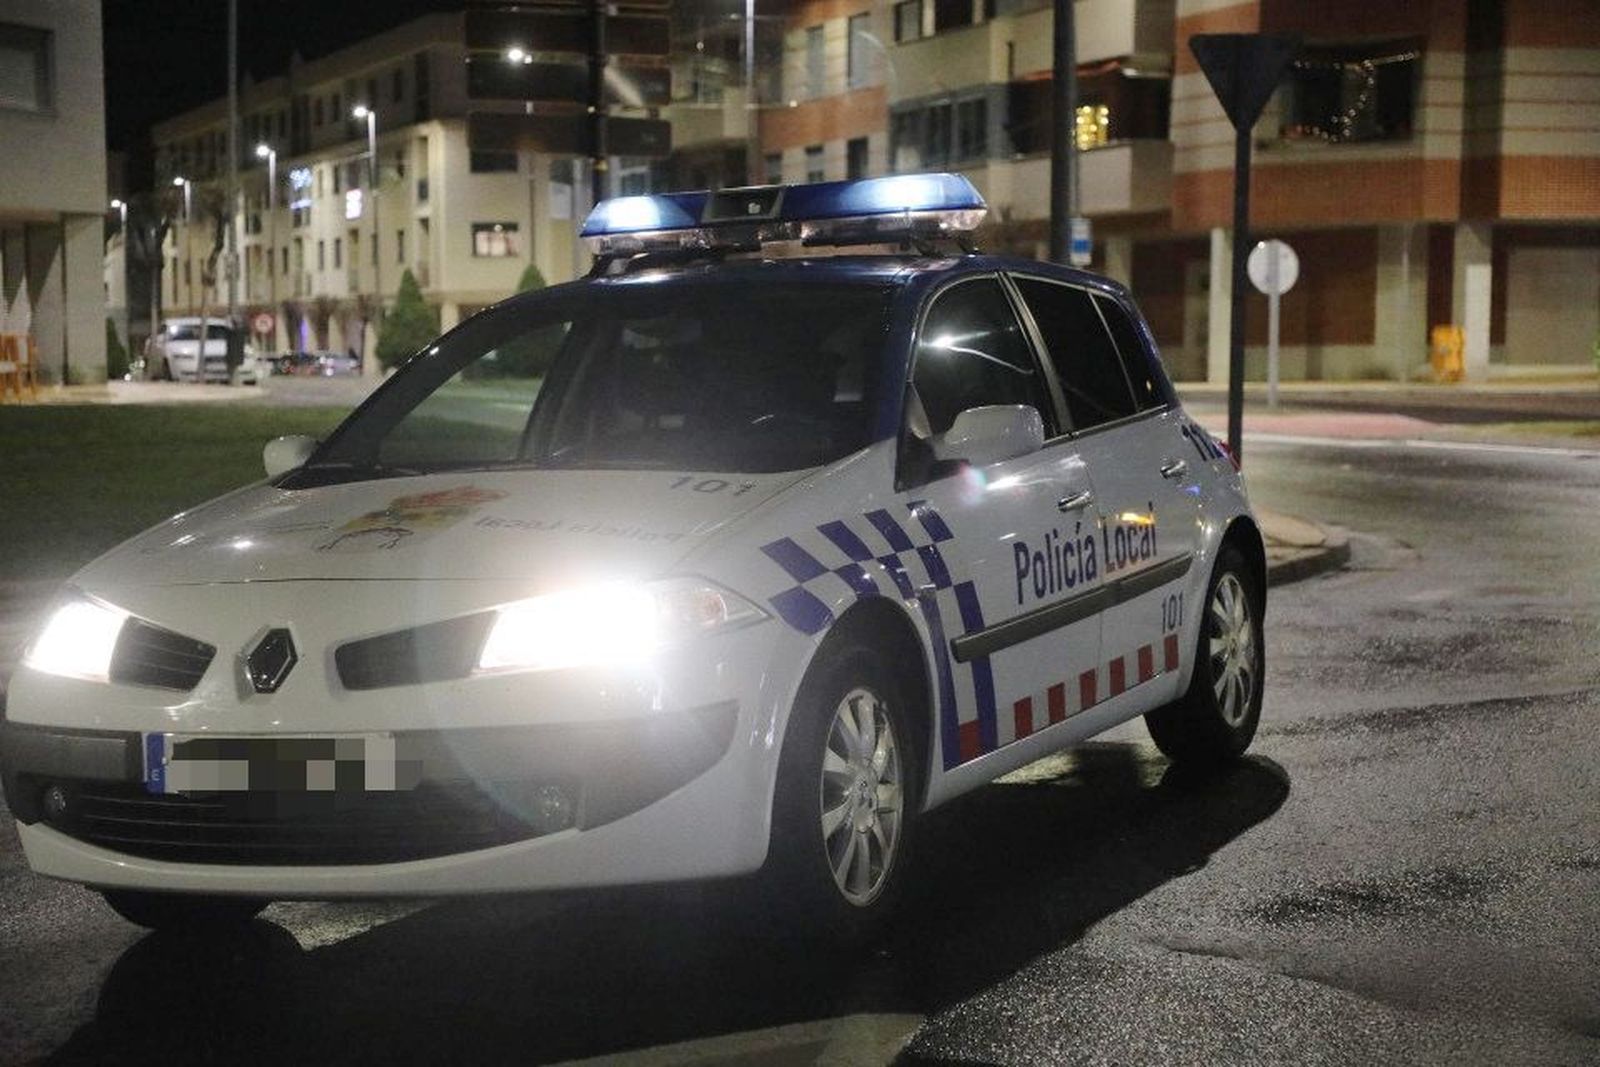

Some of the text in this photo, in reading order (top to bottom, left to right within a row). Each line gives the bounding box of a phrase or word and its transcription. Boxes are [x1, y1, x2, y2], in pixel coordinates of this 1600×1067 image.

[1013, 501, 1157, 605] Policía Local
[1161, 591, 1185, 635] 101
